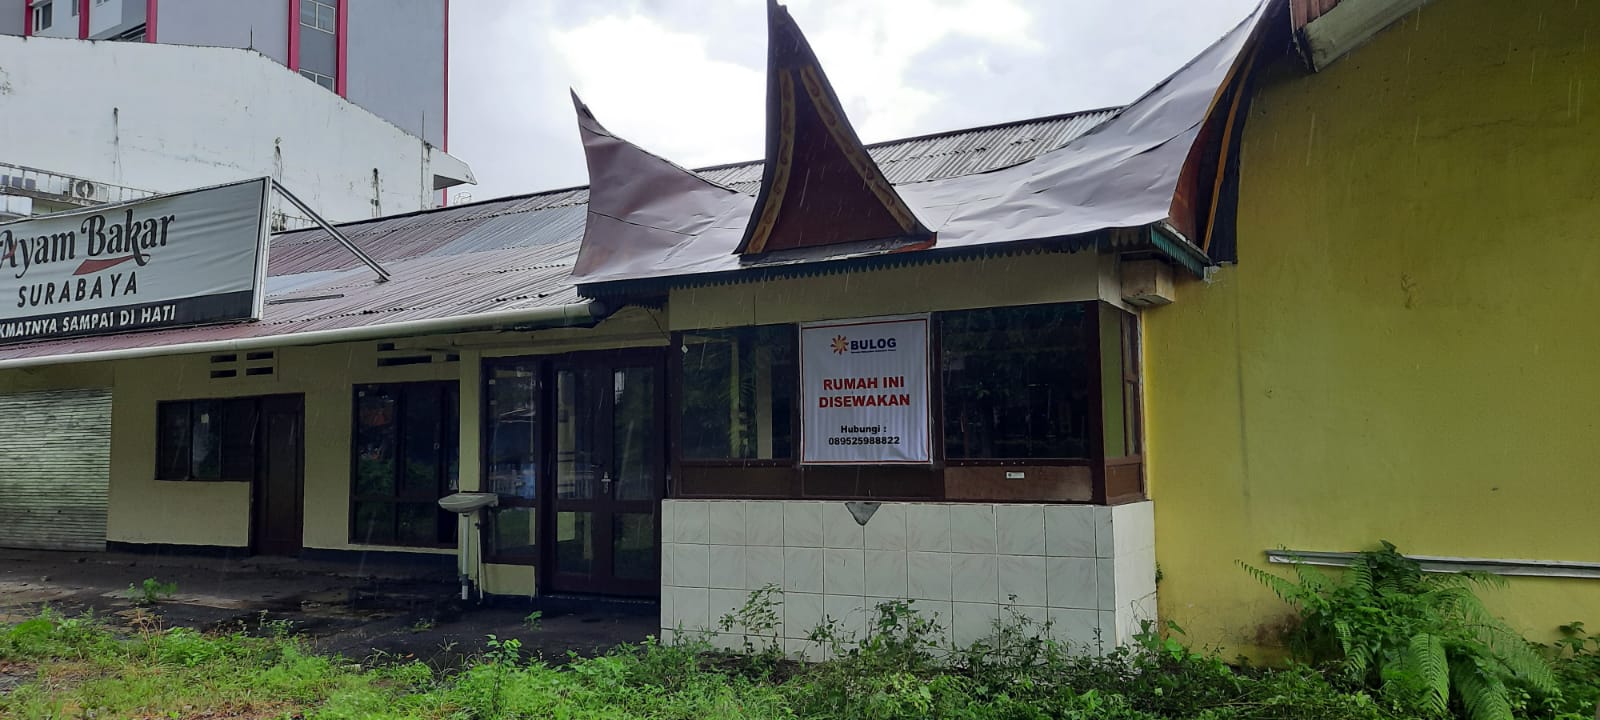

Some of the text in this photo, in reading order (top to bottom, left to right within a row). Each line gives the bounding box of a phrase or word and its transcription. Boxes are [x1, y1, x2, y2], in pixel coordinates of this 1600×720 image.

[0, 208, 176, 279] Ayam Bakar
[17, 271, 137, 308] SURABAYA
[62, 311, 114, 333] SAMPAI
[119, 310, 135, 326] DI
[140, 304, 176, 324] HATI
[850, 338, 897, 351] BULOG
[823, 376, 905, 391] RUMAH INI
[818, 394, 910, 408] DISEWAKAN
[840, 425, 881, 434] Hubungi
[828, 436, 901, 446] 089525988822
